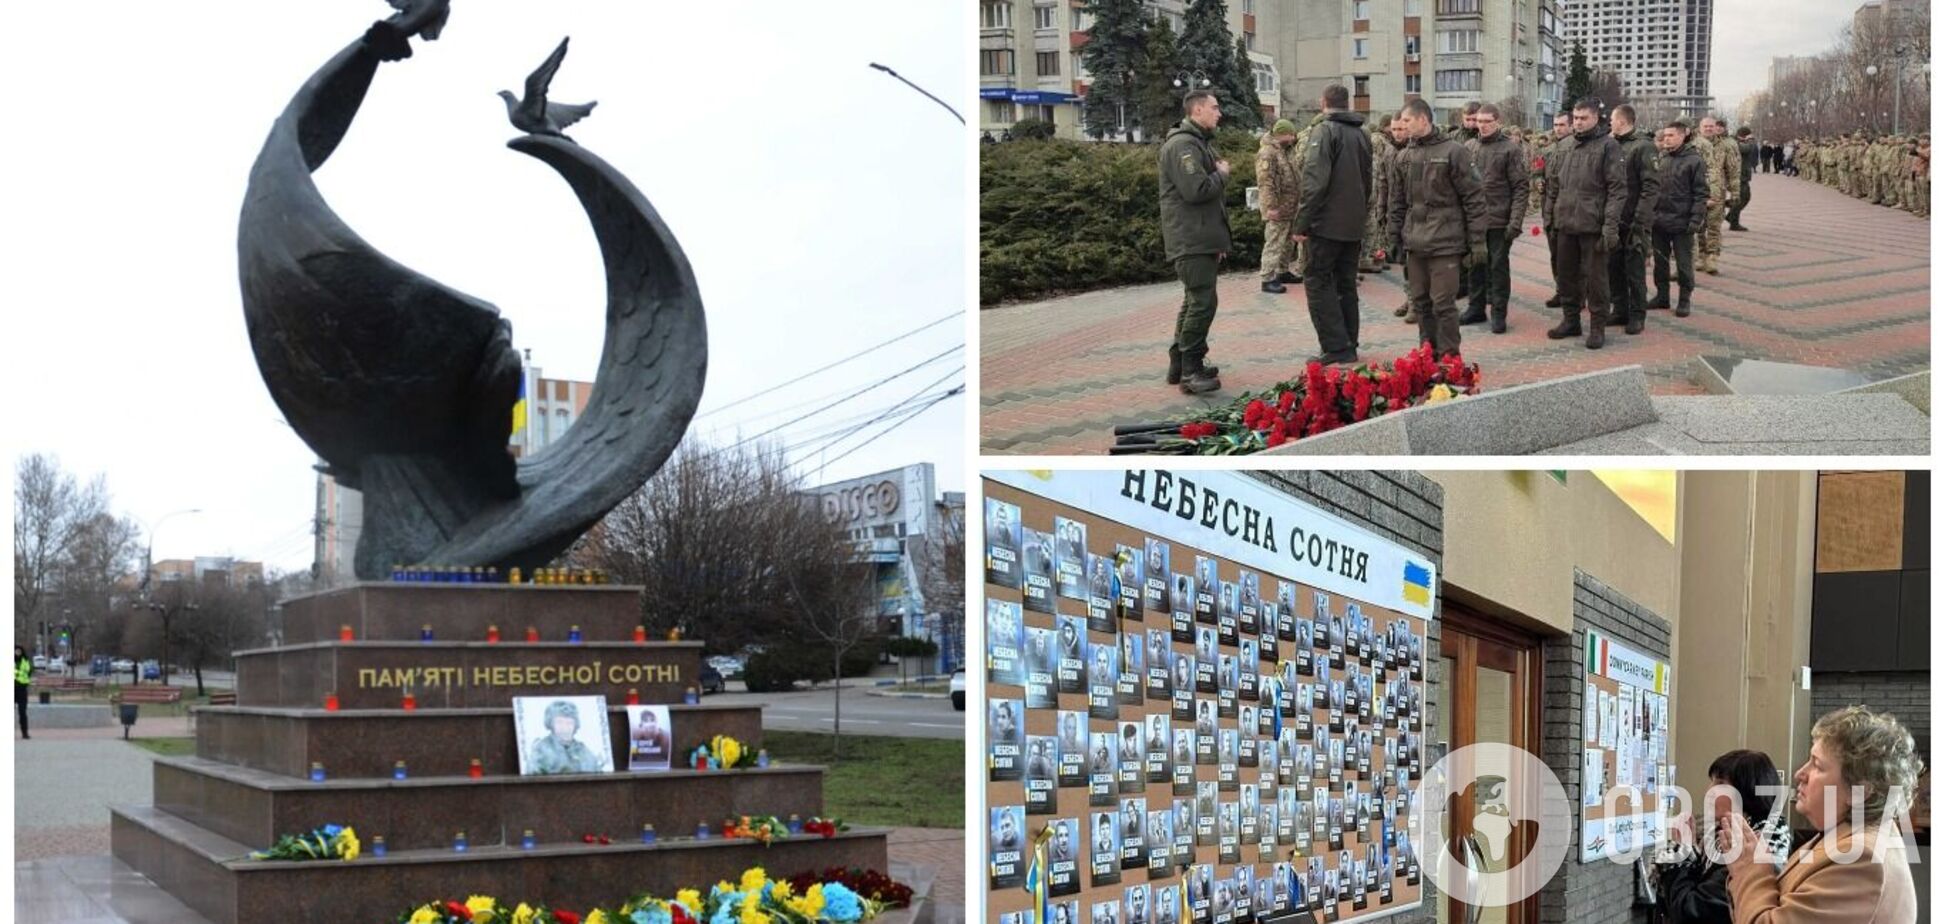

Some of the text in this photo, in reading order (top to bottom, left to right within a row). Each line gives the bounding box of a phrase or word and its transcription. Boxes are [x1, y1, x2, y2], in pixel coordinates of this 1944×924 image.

[821, 479, 899, 524] DISCO
[1121, 470, 1369, 583] НЕБЕСНА СОТНЯ
[473, 661, 601, 687] НЕБЕСНОЇ
[608, 664, 679, 683] СОТНІ
